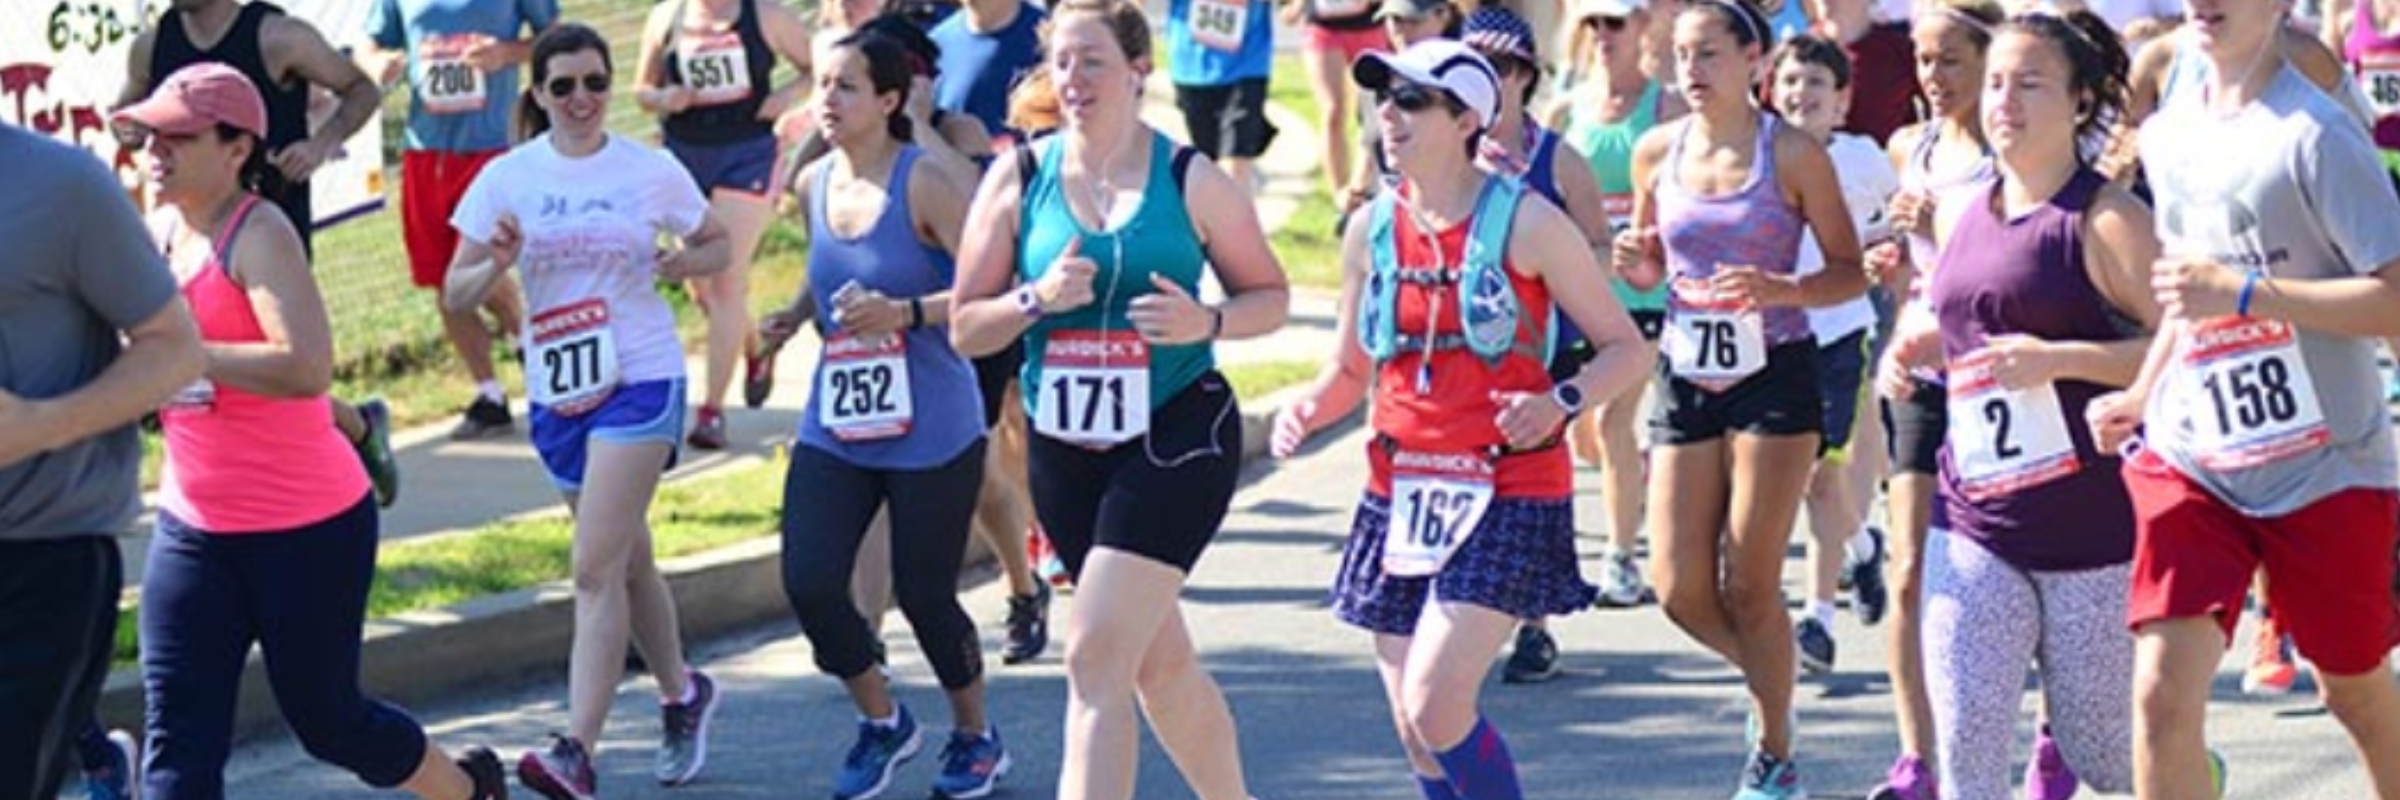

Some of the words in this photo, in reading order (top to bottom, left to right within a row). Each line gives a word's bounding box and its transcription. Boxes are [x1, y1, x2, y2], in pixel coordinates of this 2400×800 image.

[427, 62, 476, 96] 200
[688, 54, 735, 89] 551
[543, 336, 602, 397] 277
[1691, 320, 1739, 370] 76
[830, 364, 897, 418] 252
[1052, 375, 1125, 432] 171
[2203, 355, 2298, 436] 158
[1984, 397, 2023, 460] 2
[1406, 487, 1476, 548] 162
